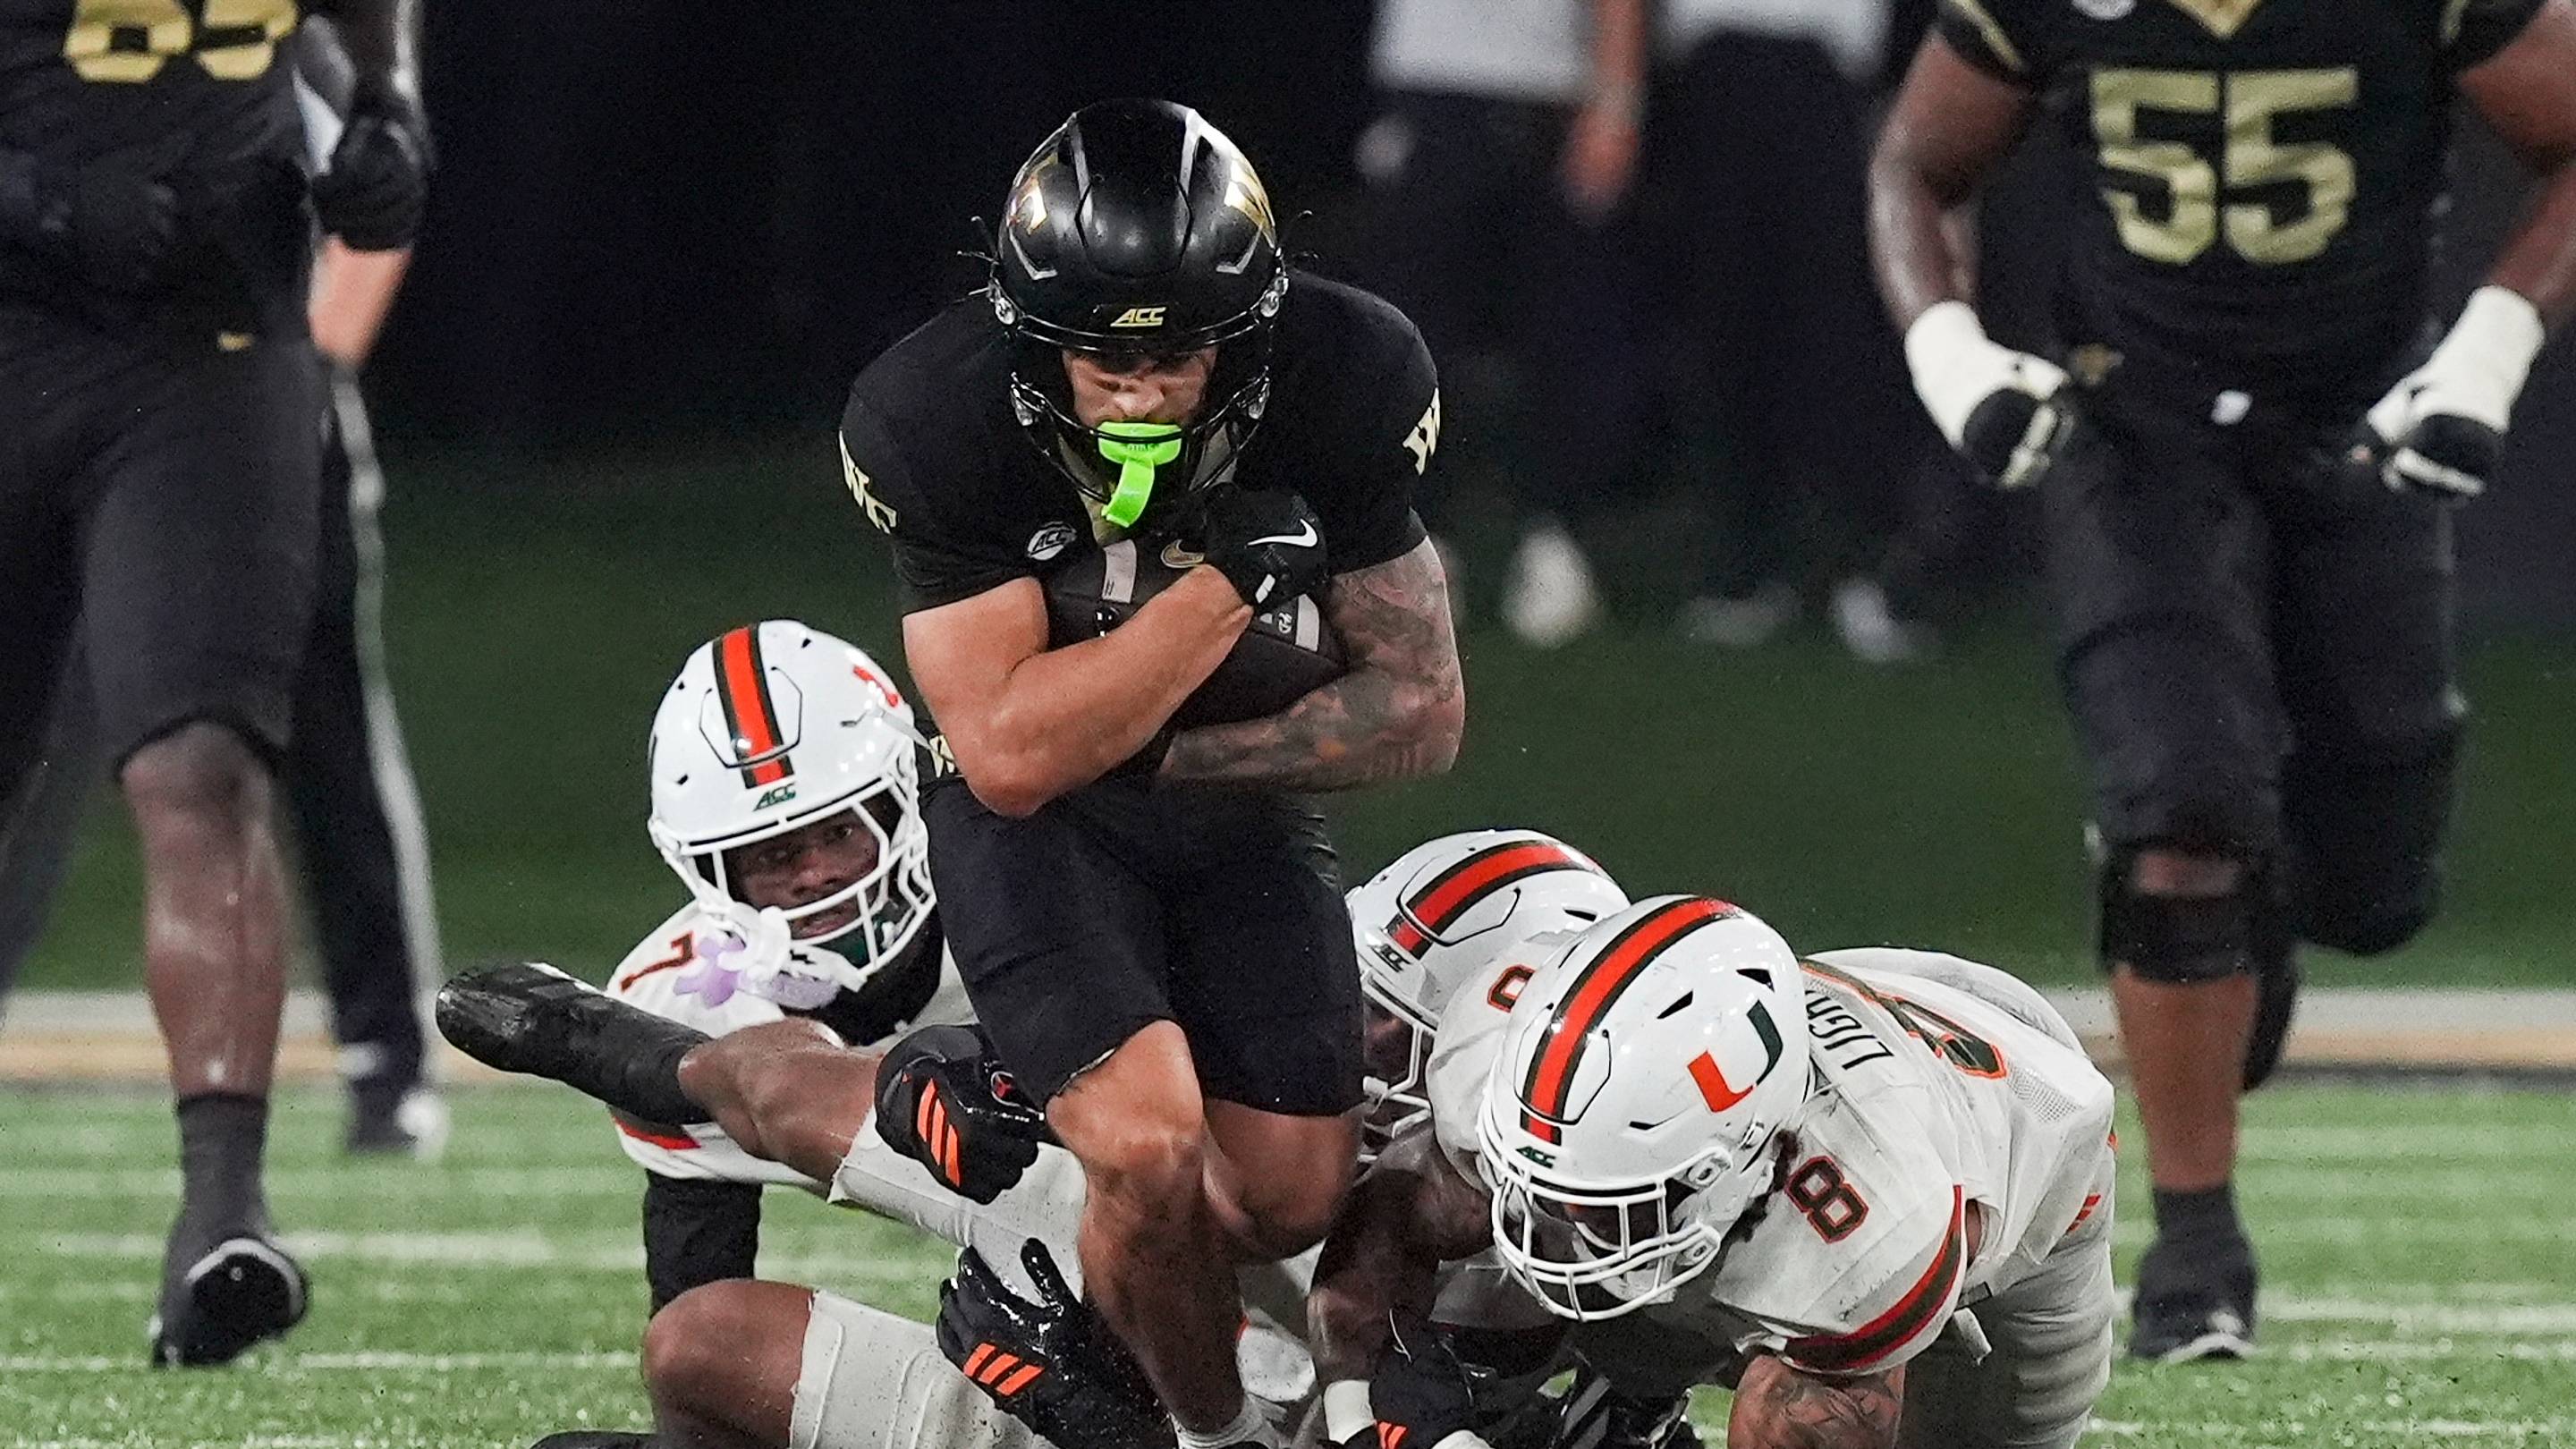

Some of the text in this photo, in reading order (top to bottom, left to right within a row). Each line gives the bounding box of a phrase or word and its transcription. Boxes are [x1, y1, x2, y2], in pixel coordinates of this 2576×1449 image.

[2089, 66, 2359, 263] 55
[1110, 306, 1166, 327] ACC
[752, 781, 797, 812] ACC
[620, 930, 696, 993] 7
[1687, 998, 1784, 1114] U
[1515, 1145, 1556, 1169] ACC
[1784, 1155, 1869, 1245] 8
